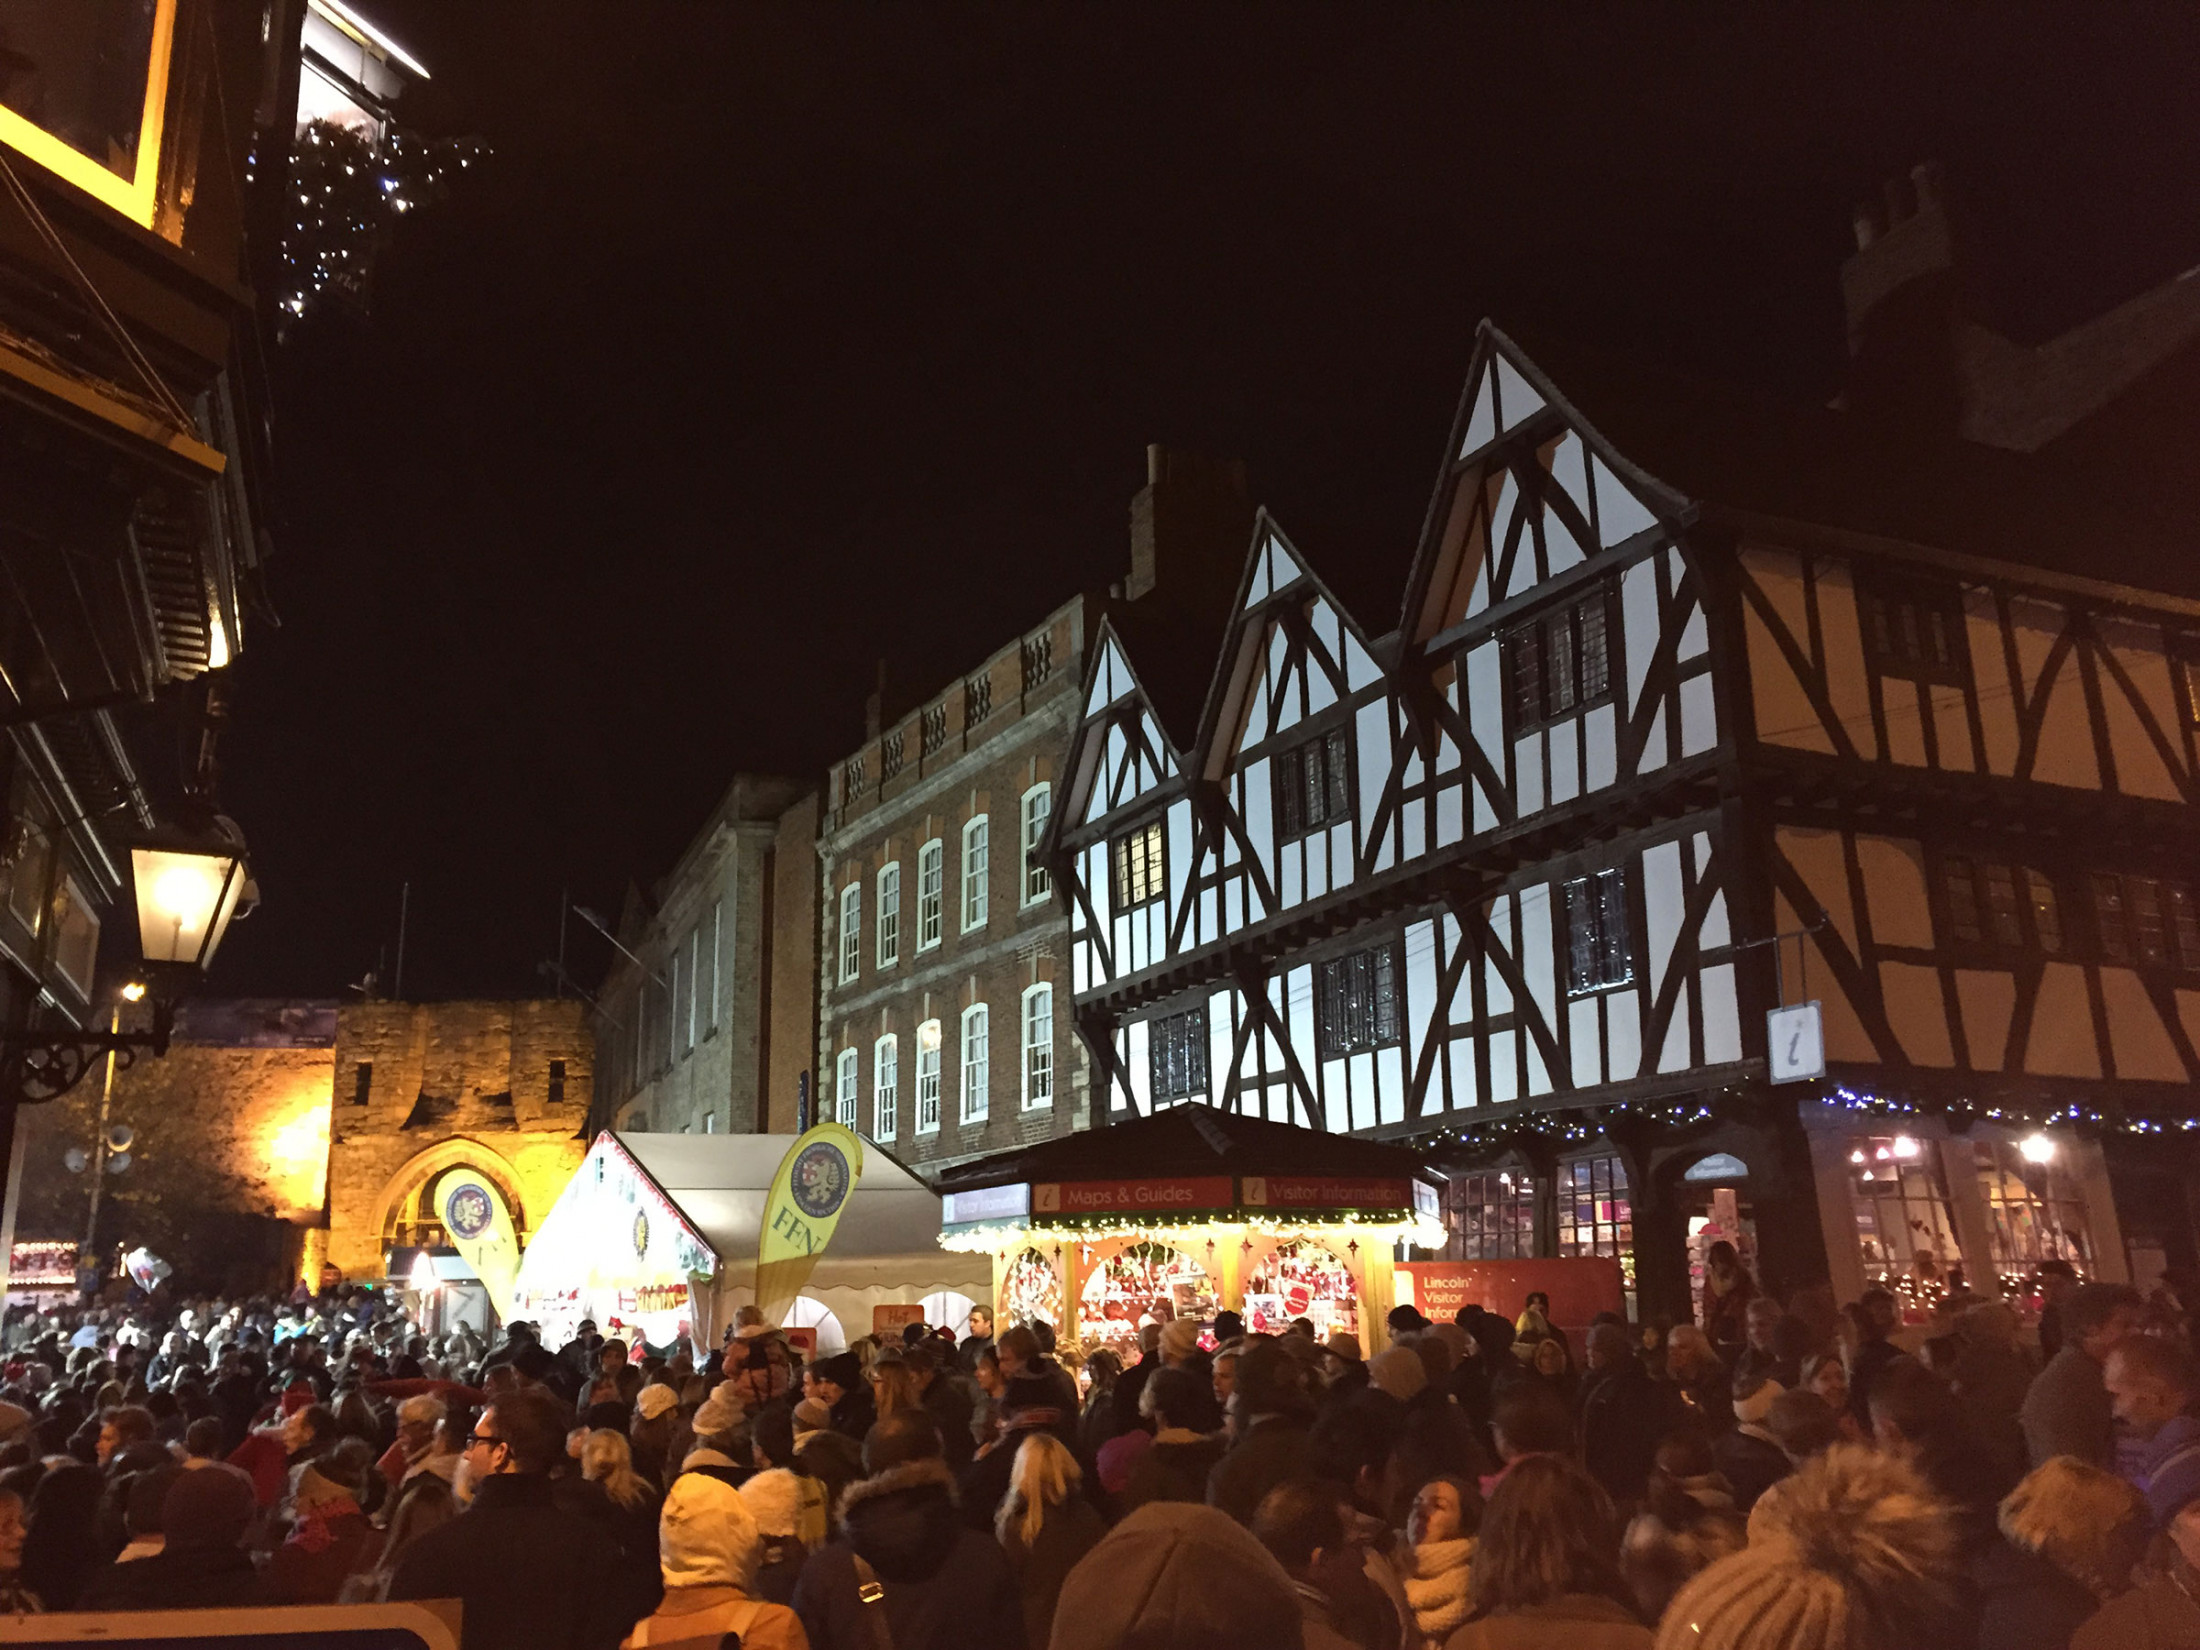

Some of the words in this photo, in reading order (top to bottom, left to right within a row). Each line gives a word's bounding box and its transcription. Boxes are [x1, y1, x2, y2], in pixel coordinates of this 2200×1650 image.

[1068, 1189, 1112, 1206] Maps
[1117, 1187, 1130, 1203] &
[1135, 1185, 1194, 1203] Guides
[1272, 1183, 1319, 1200] Visitor
[1322, 1183, 1402, 1202] Information
[1423, 1276, 1470, 1288] Lincoln
[1423, 1291, 1464, 1303] Visitor
